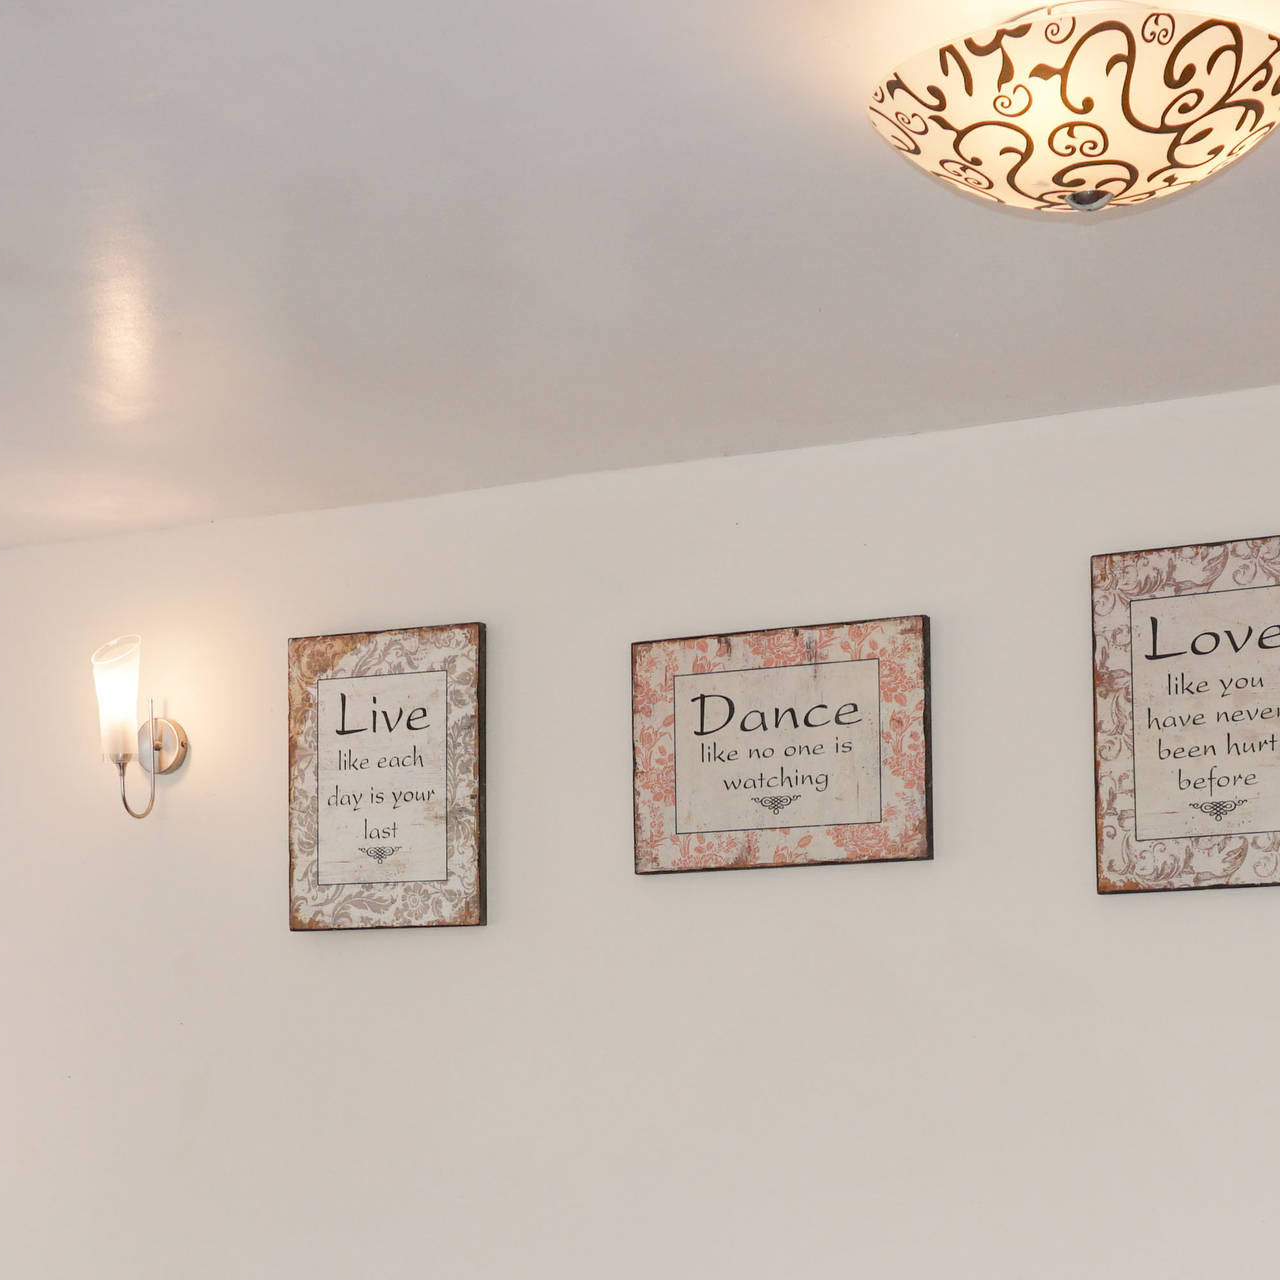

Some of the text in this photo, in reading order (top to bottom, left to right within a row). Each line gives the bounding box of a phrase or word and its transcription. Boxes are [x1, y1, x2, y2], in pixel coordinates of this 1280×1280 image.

[1167, 671, 1265, 699] like you
[335, 692, 431, 736] Live
[690, 693, 863, 737] Dance
[1147, 706, 1208, 731] have
[338, 744, 425, 771] like each
[700, 736, 853, 763] like no one is
[1158, 732, 1278, 761] been hurt
[723, 765, 829, 793] watching
[1178, 764, 1259, 796] before
[327, 784, 437, 812] day is your
[364, 816, 398, 840] last
